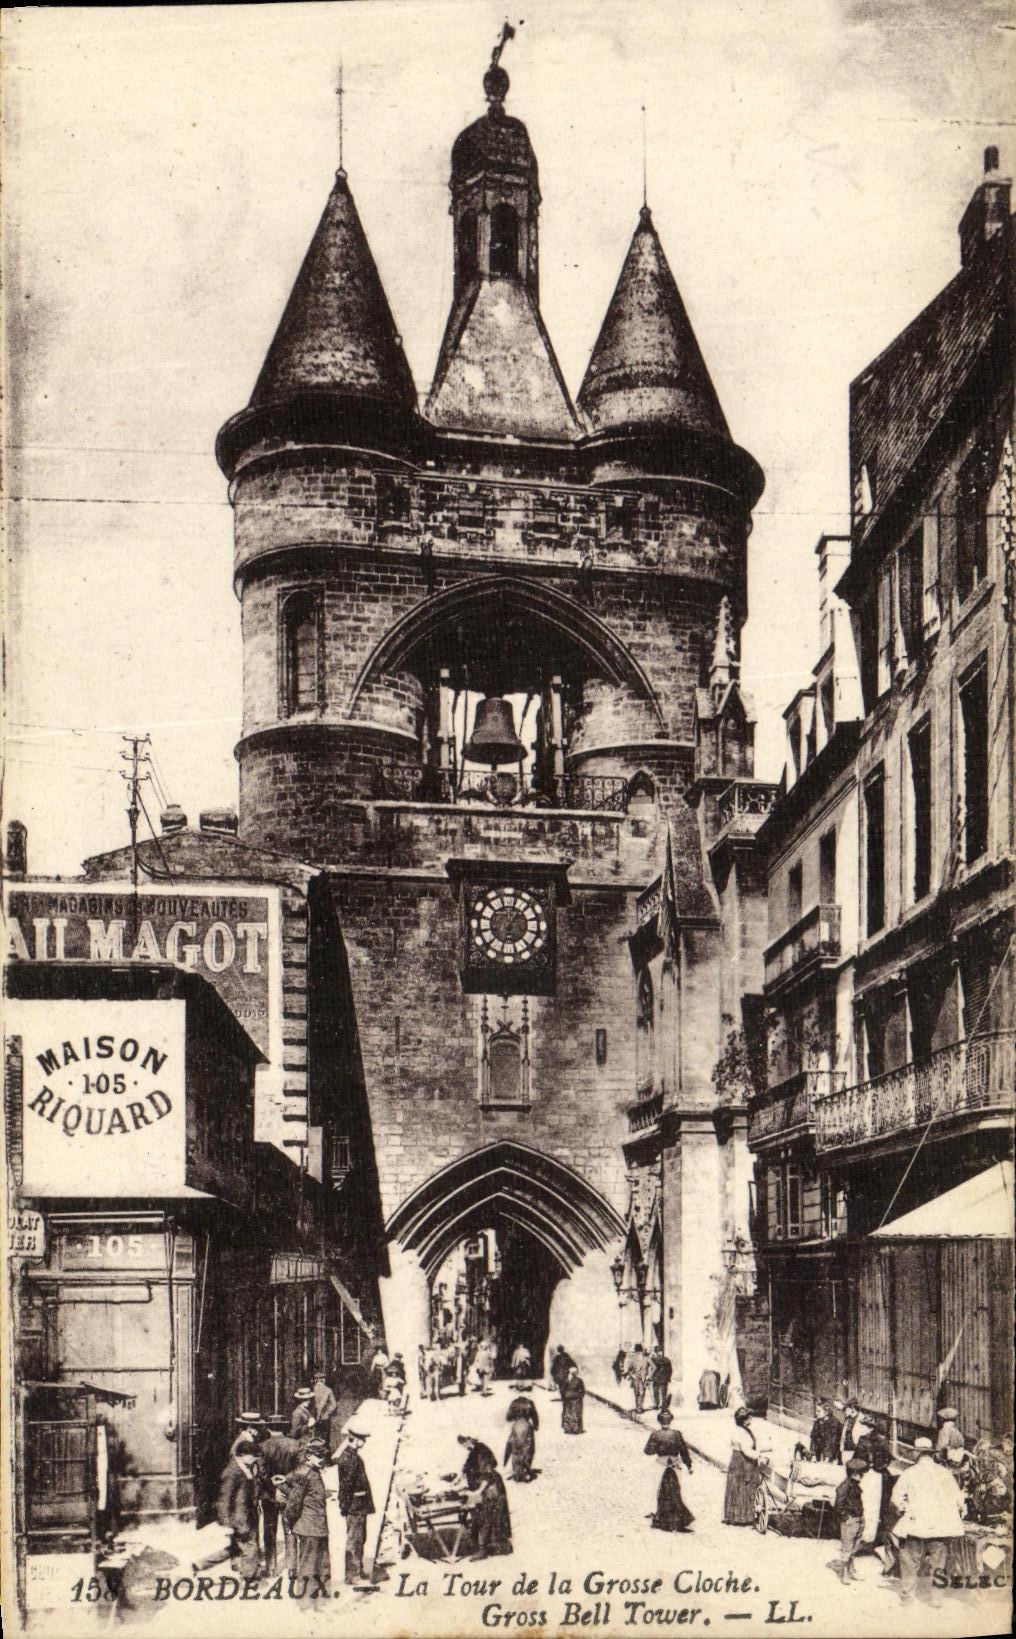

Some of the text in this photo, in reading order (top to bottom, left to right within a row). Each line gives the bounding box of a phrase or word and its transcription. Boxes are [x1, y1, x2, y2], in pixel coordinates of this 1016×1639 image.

[87, 919, 268, 974] MAGOT
[36, 1035, 168, 1077] MAISON
[28, 1085, 173, 1138] RIQUARD
